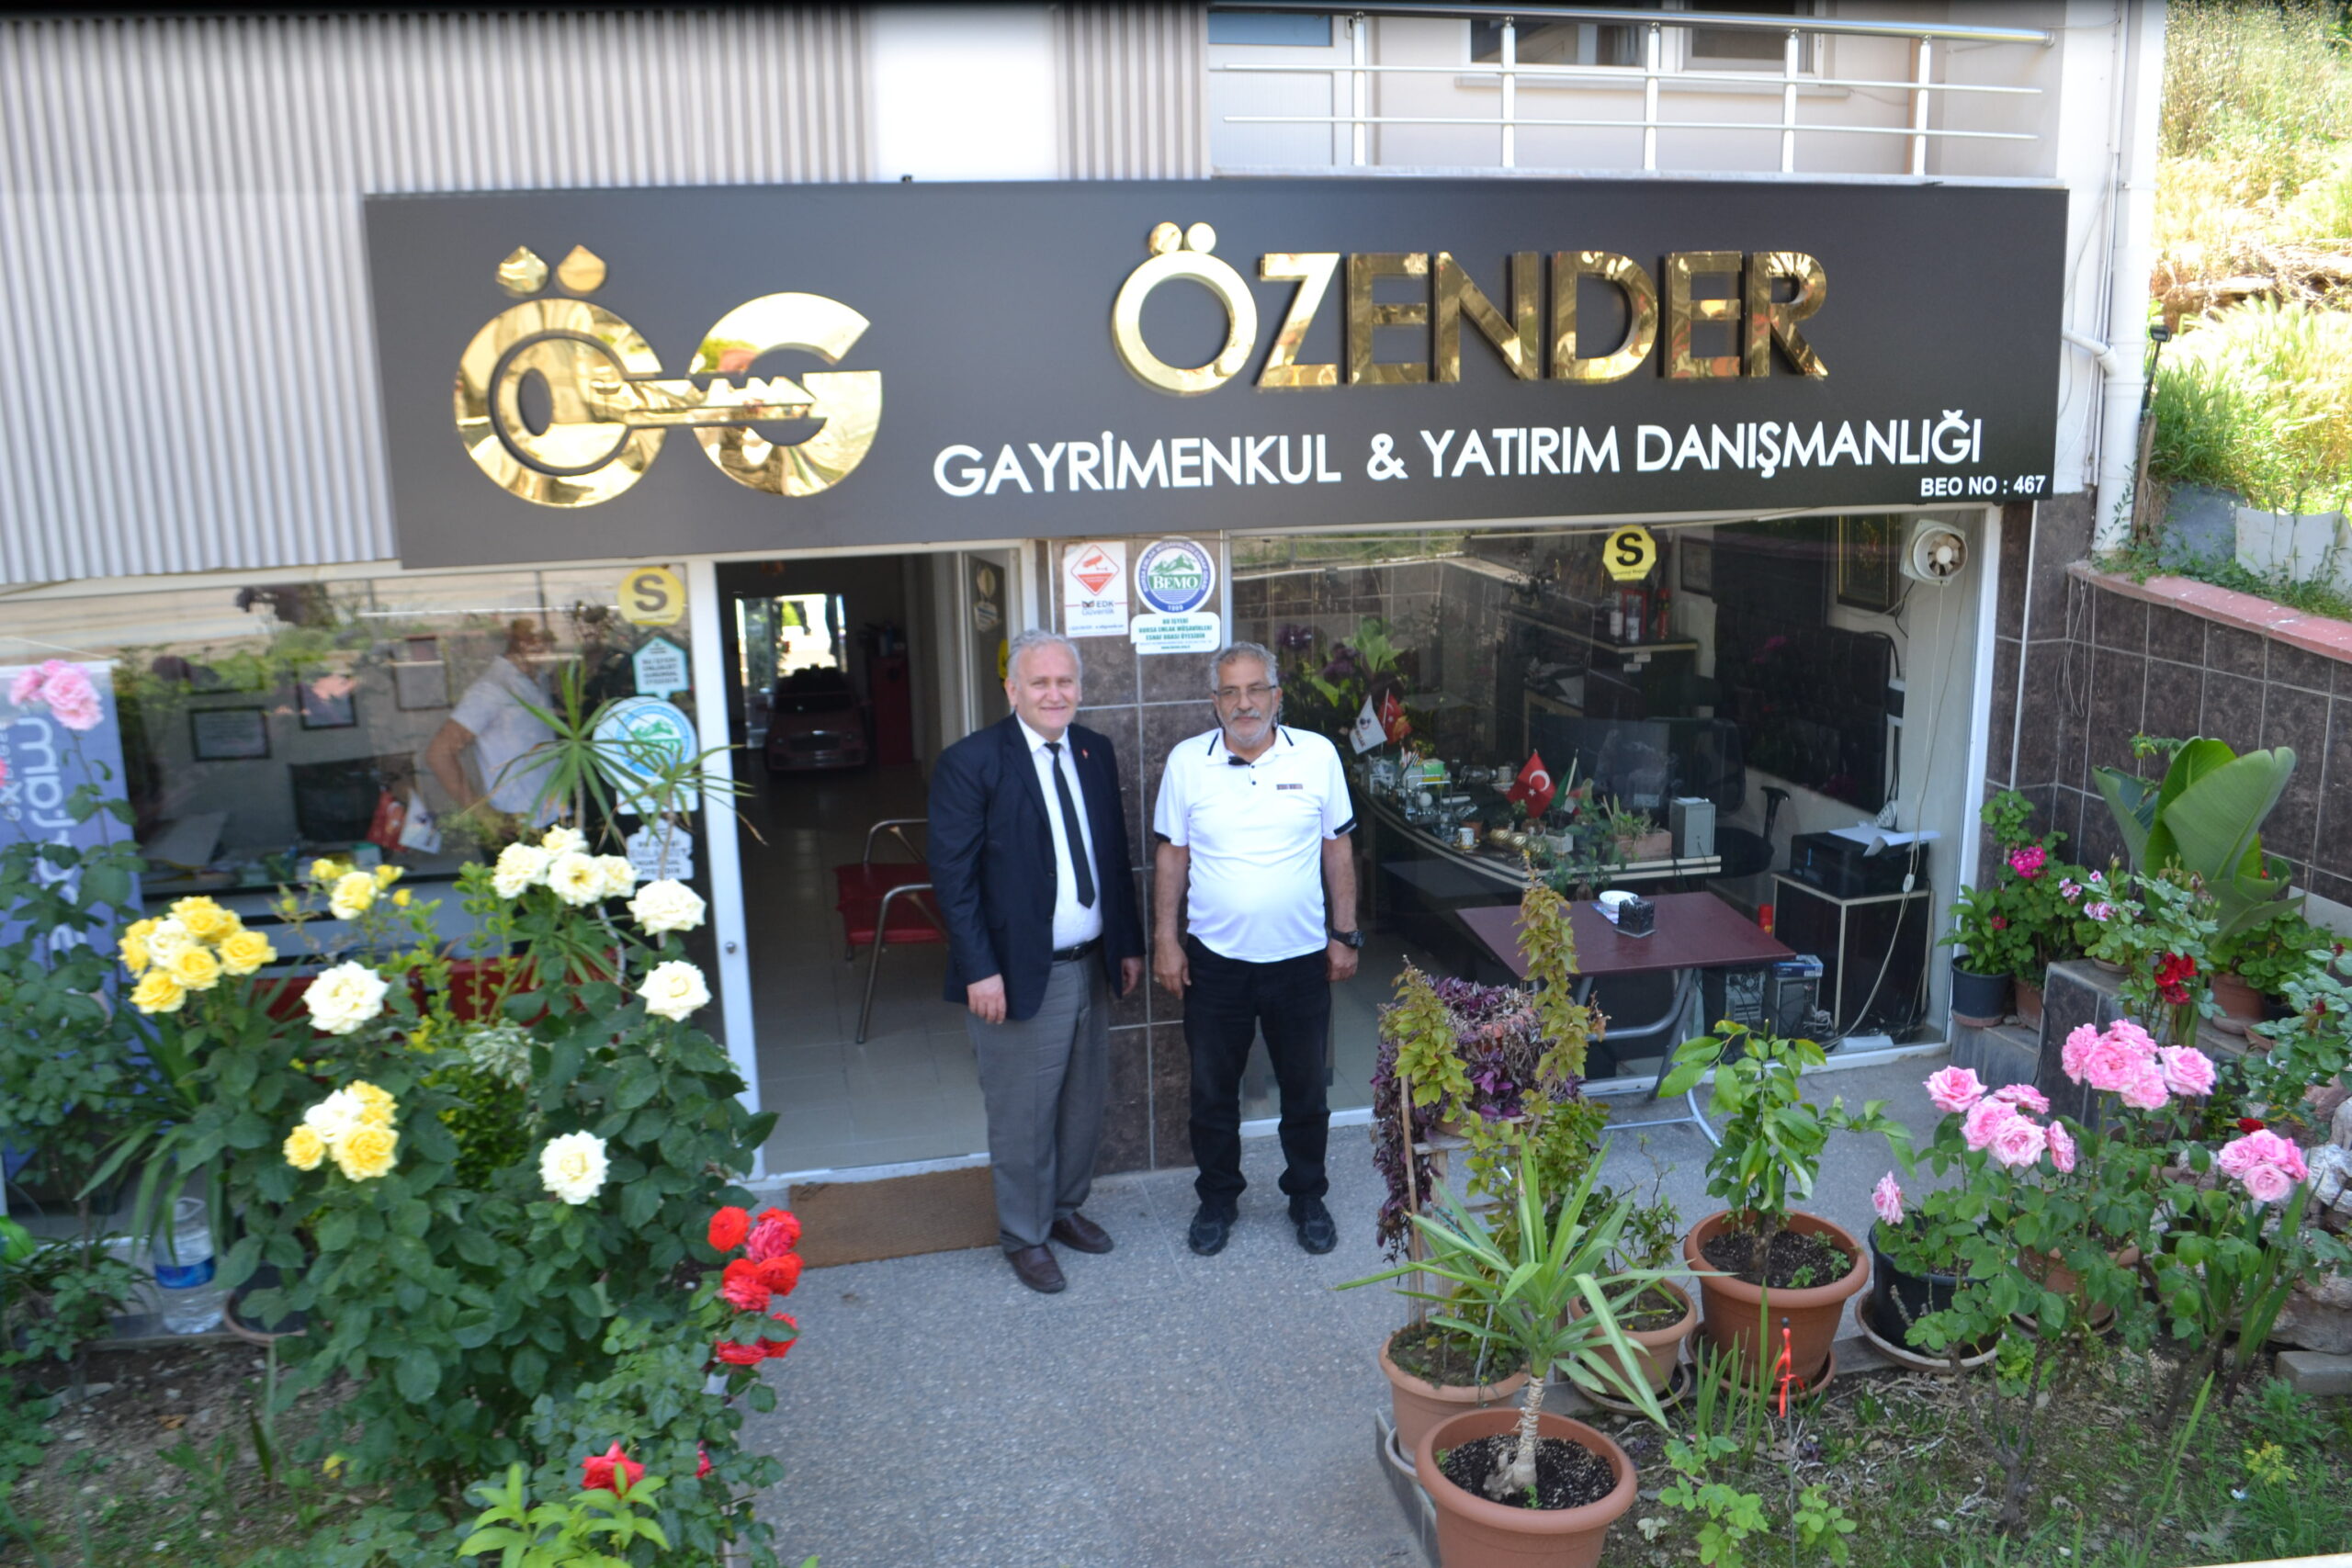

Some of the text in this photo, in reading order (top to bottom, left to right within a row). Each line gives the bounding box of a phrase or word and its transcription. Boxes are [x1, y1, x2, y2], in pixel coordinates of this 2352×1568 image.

[1111, 221, 1829, 395] ÖZENDER
[933, 409, 1982, 497] GAYRİMENKUL & YATIRIM DANIŞMANLIĞI
[1920, 477, 1963, 497] BEO
[1968, 476, 1997, 495] NO
[2013, 475, 2046, 494] 467
[1616, 532, 1644, 566] S
[633, 574, 668, 612] S
[1153, 575, 1198, 590] BEMO
